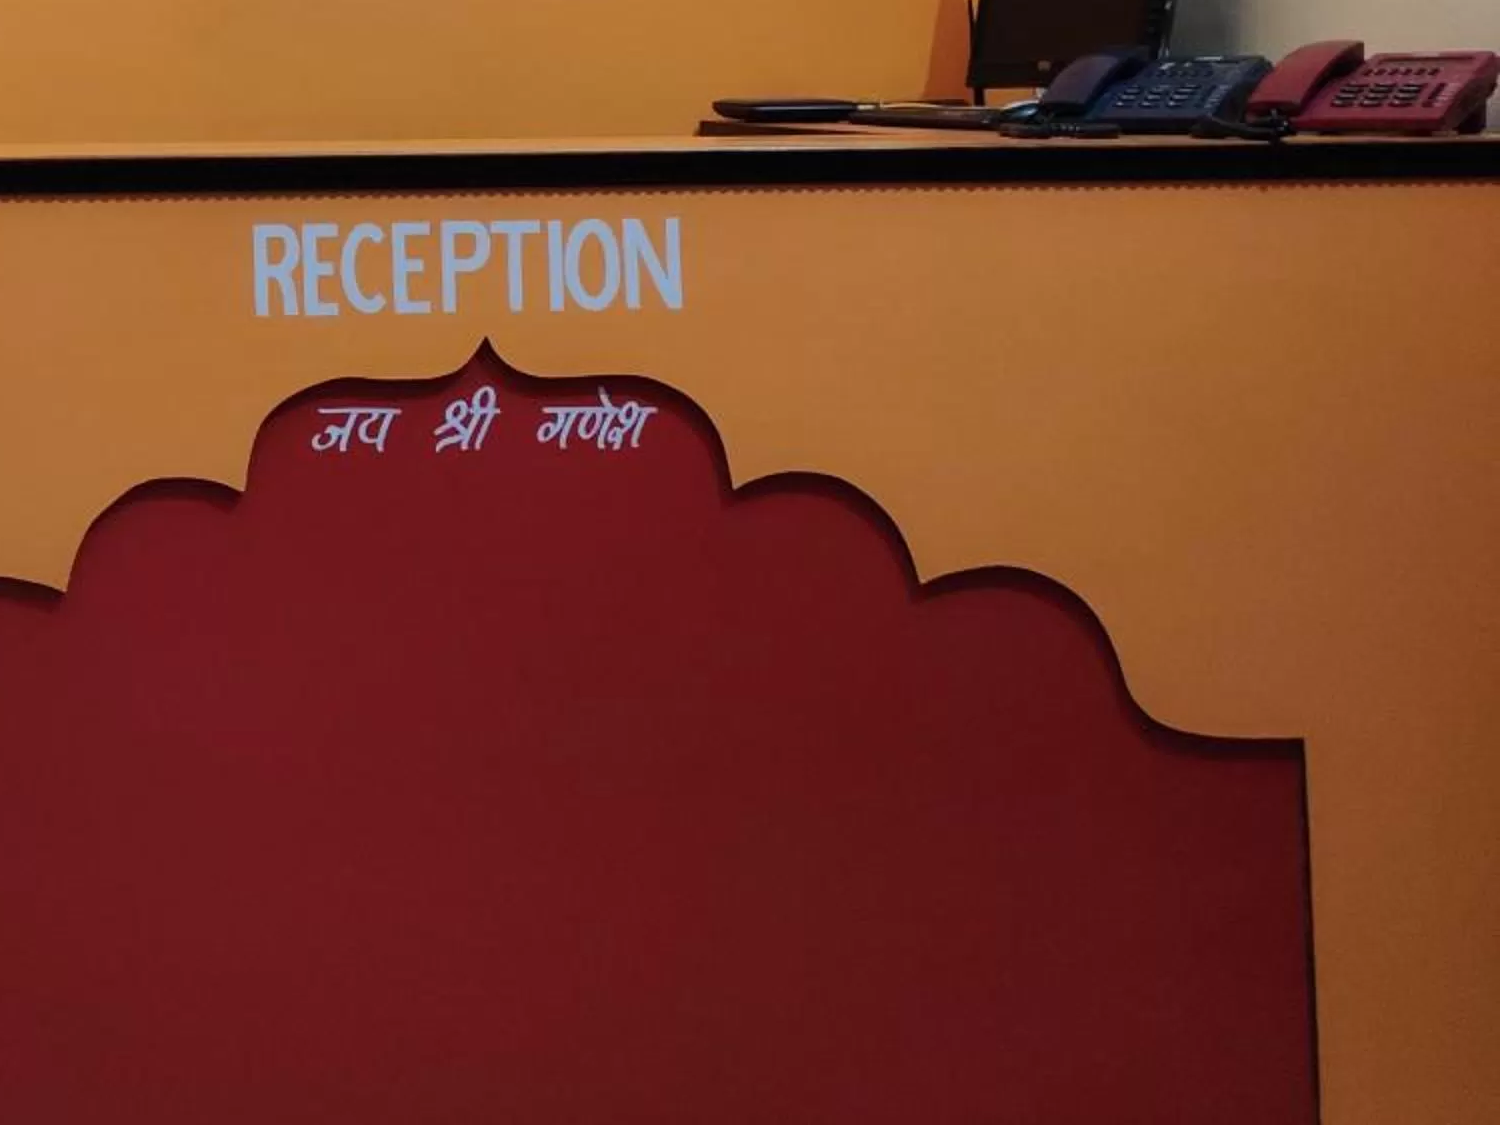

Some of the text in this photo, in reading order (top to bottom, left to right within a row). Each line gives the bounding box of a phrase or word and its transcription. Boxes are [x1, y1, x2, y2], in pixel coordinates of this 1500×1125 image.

[252, 217, 684, 317] RECEPTION
[311, 385, 658, 453] जय श्री गणेश
